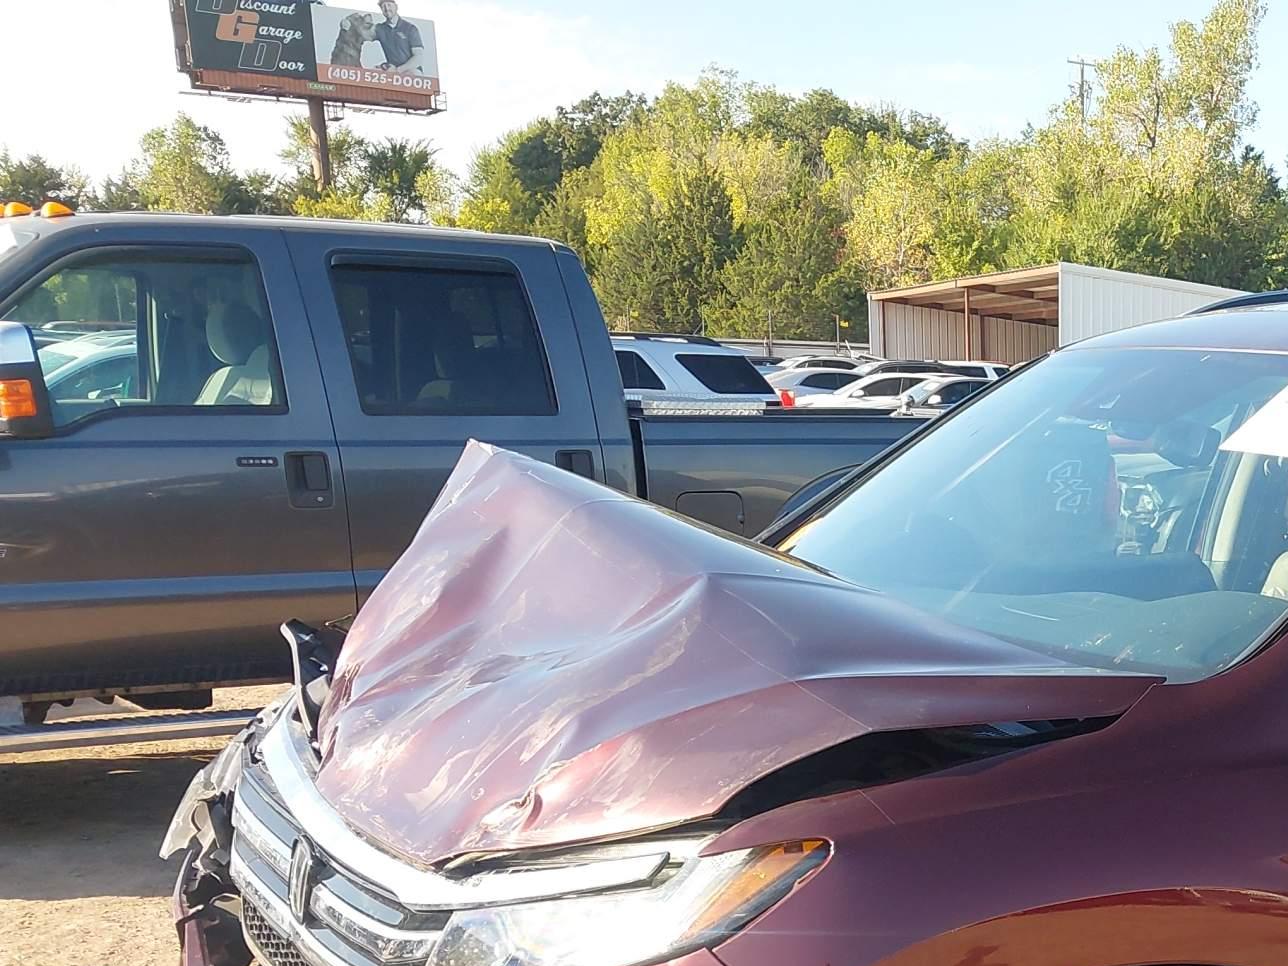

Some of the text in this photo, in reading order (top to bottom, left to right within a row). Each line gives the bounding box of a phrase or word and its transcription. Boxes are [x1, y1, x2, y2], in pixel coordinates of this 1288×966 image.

[215, 9, 303, 44] Garage
[238, 38, 305, 72] Door
[327, 66, 432, 90] (405) 525-DOOR
